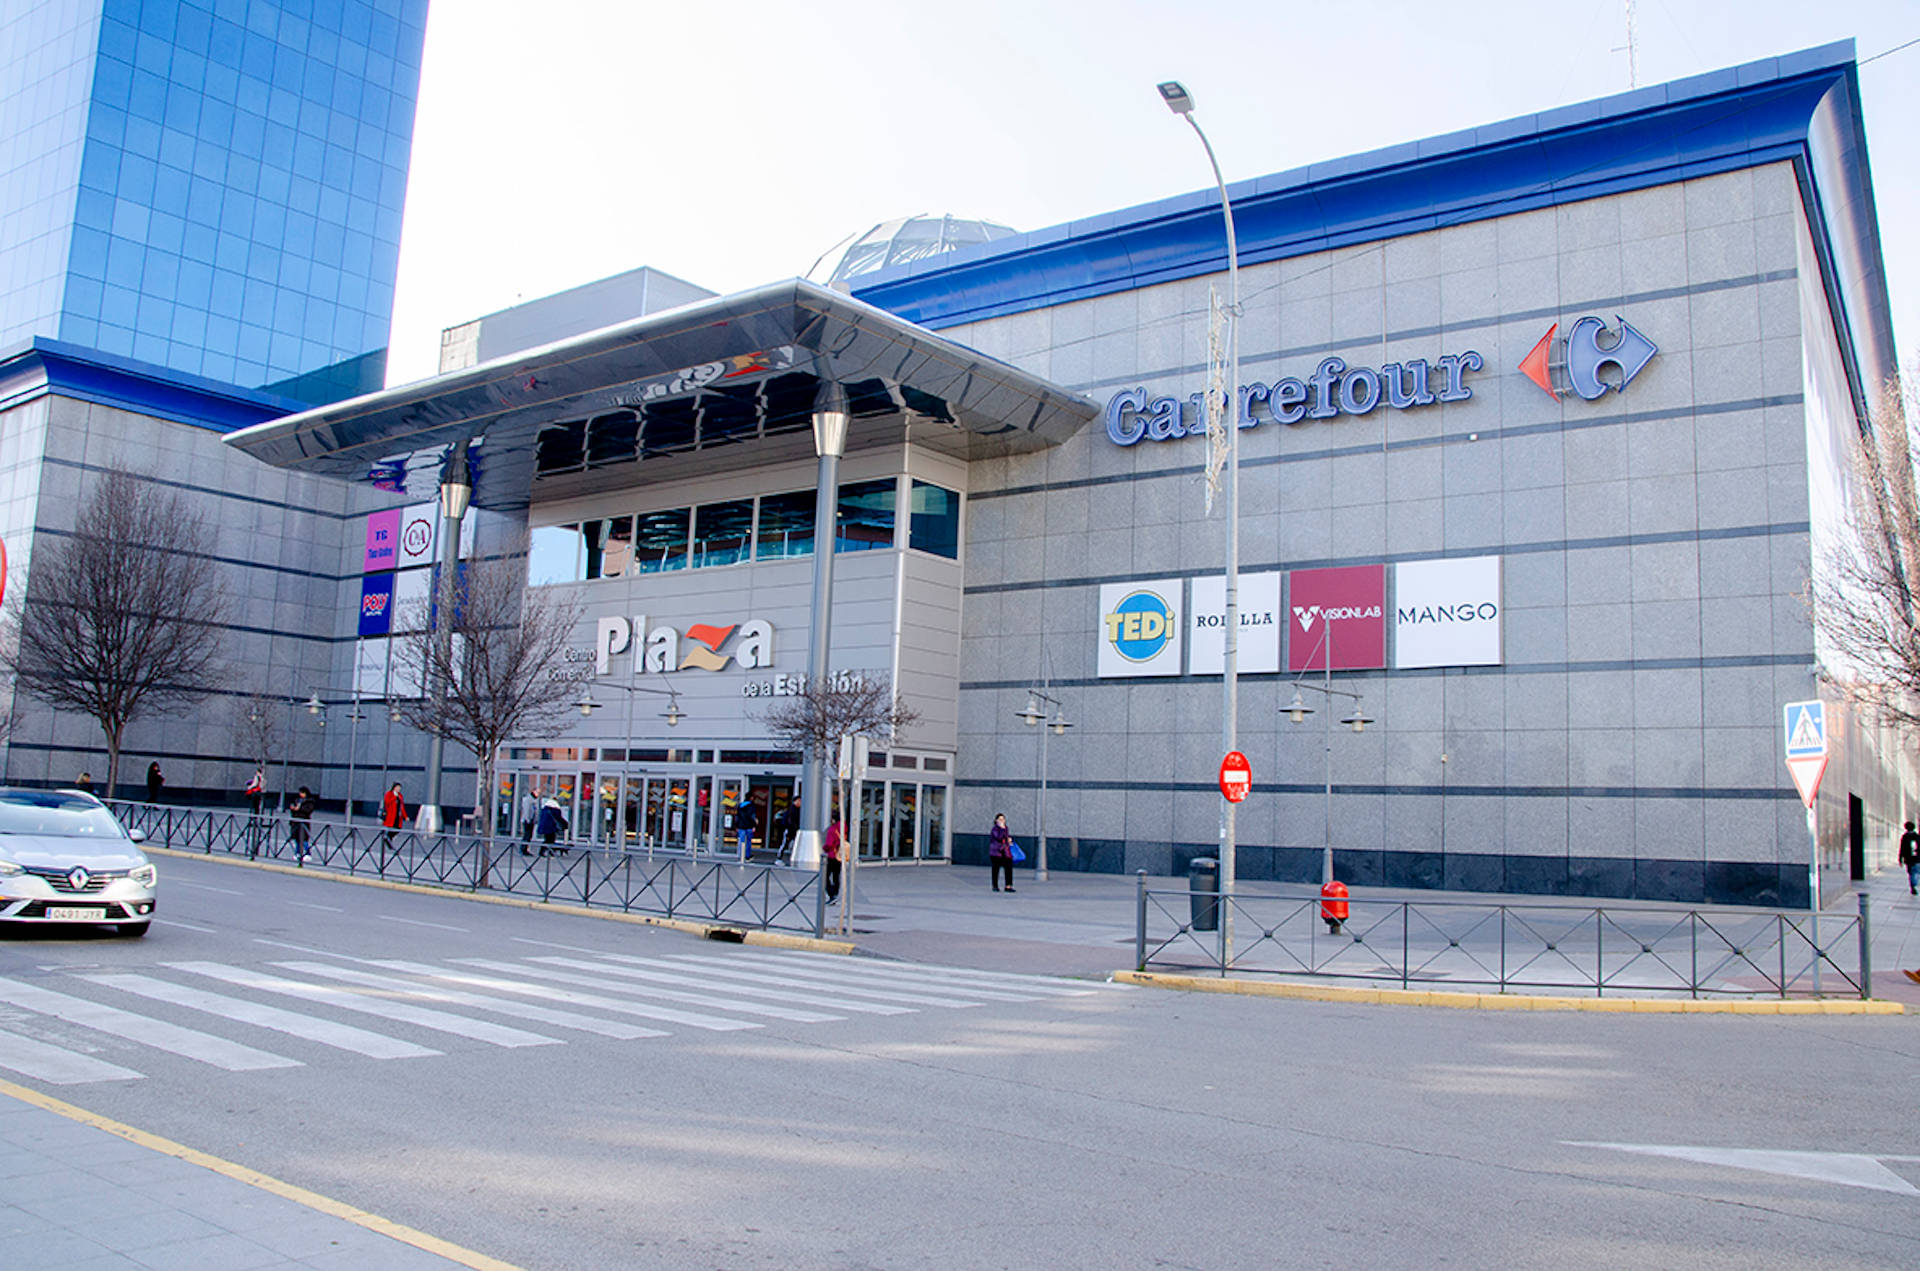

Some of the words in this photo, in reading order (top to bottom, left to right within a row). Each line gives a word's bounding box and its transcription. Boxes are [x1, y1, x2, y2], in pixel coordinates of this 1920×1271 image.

[1105, 350, 1484, 447] Carrefour
[1105, 609, 1176, 643] TEDi
[1197, 612, 1272, 627] ROLLA
[1319, 606, 1382, 621] VISIONLAB
[1398, 602, 1497, 625] MANGO
[596, 614, 774, 675] Plaza
[741, 681, 759, 697] de
[760, 679, 774, 696] la
[774, 668, 863, 696] Estión
